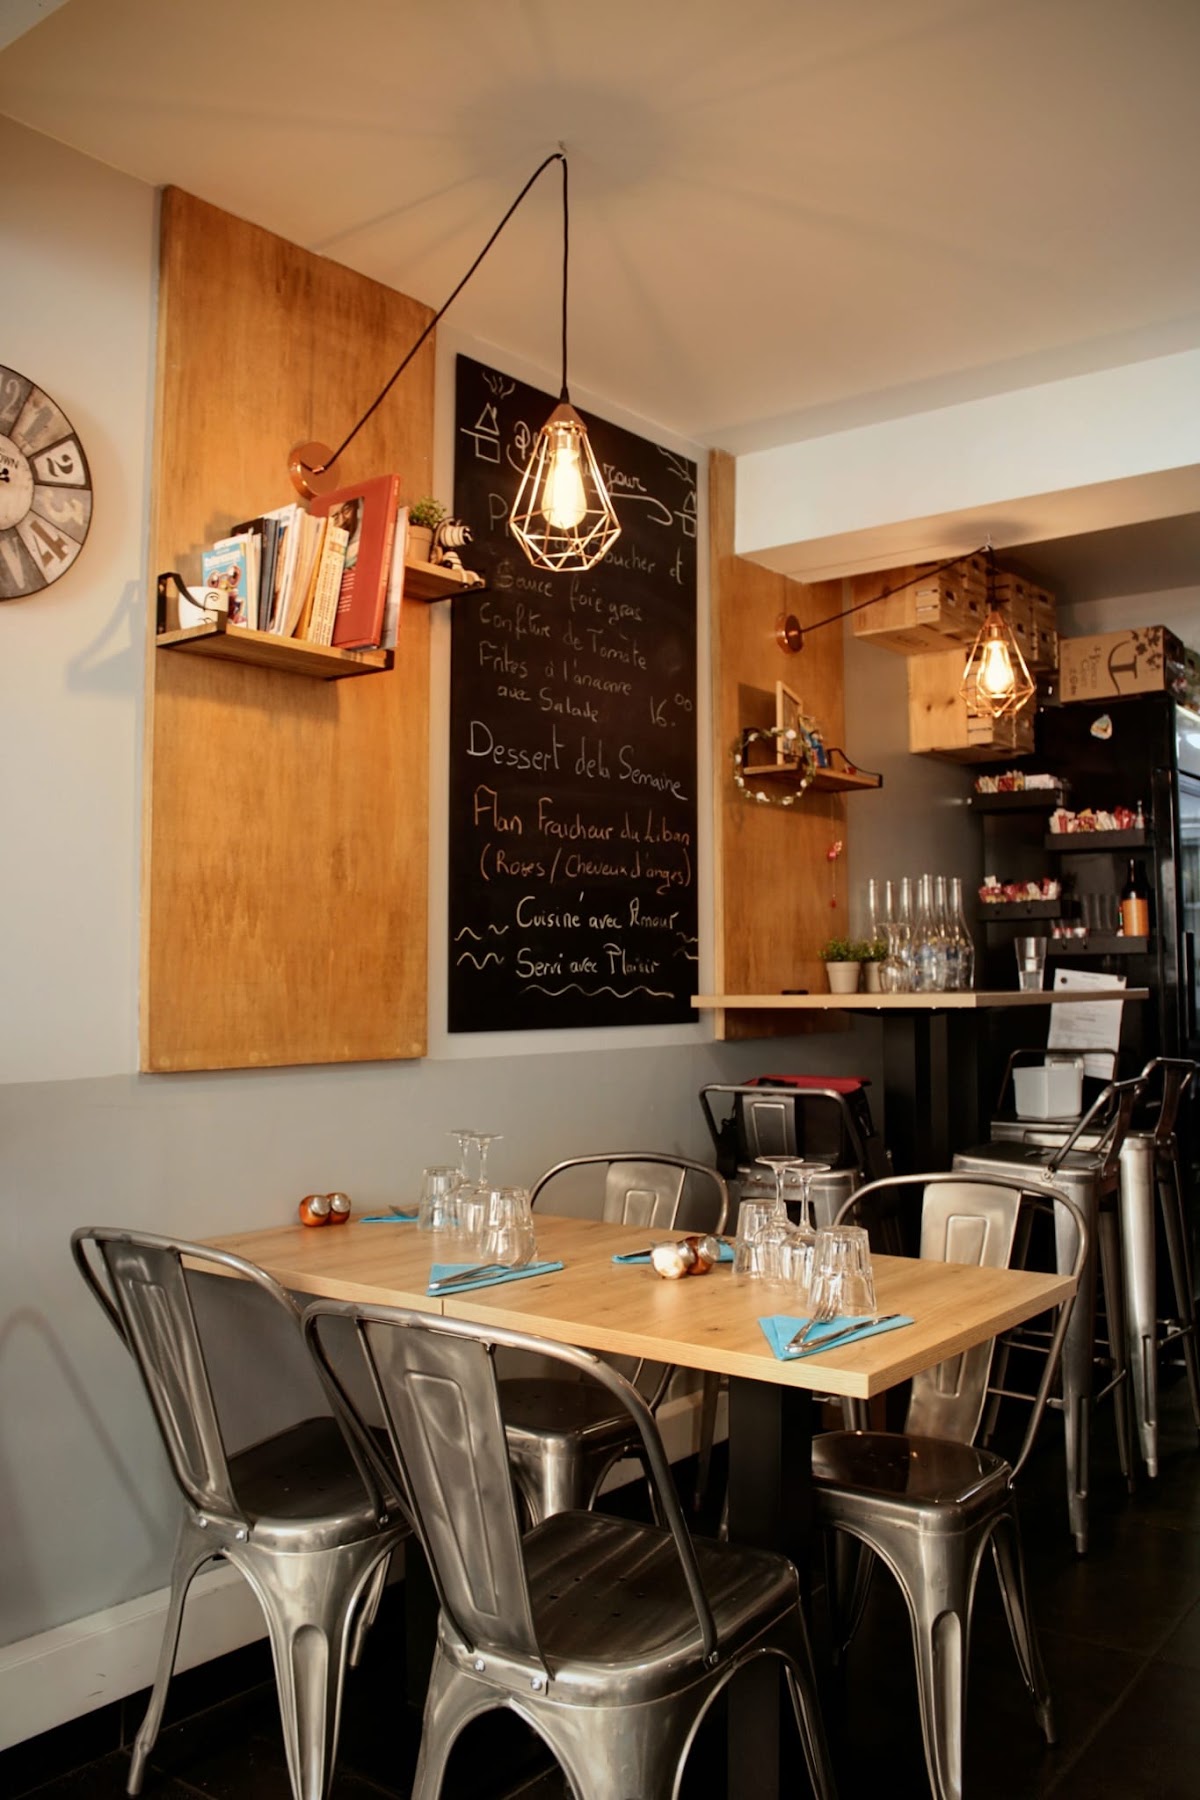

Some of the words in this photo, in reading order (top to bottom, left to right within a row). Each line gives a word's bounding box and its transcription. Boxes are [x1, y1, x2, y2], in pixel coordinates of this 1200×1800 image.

[46, 453, 74, 478] 2
[43, 489, 84, 526] 3
[30, 520, 69, 569] 4
[608, 604, 642, 626] gras
[562, 619, 584, 651] de
[479, 640, 528, 679] Frites
[497, 685, 532, 701] avec
[538, 687, 599, 723] Salade
[466, 720, 566, 772] Dessert
[618, 744, 689, 801] Semaine
[620, 811, 641, 843] du
[642, 809, 691, 846] Liban
[588, 913, 623, 930] avec
[629, 897, 680, 930] Amour
[515, 947, 563, 979] Servi
[569, 956, 599, 975] avec
[603, 942, 660, 977] Plaisir
